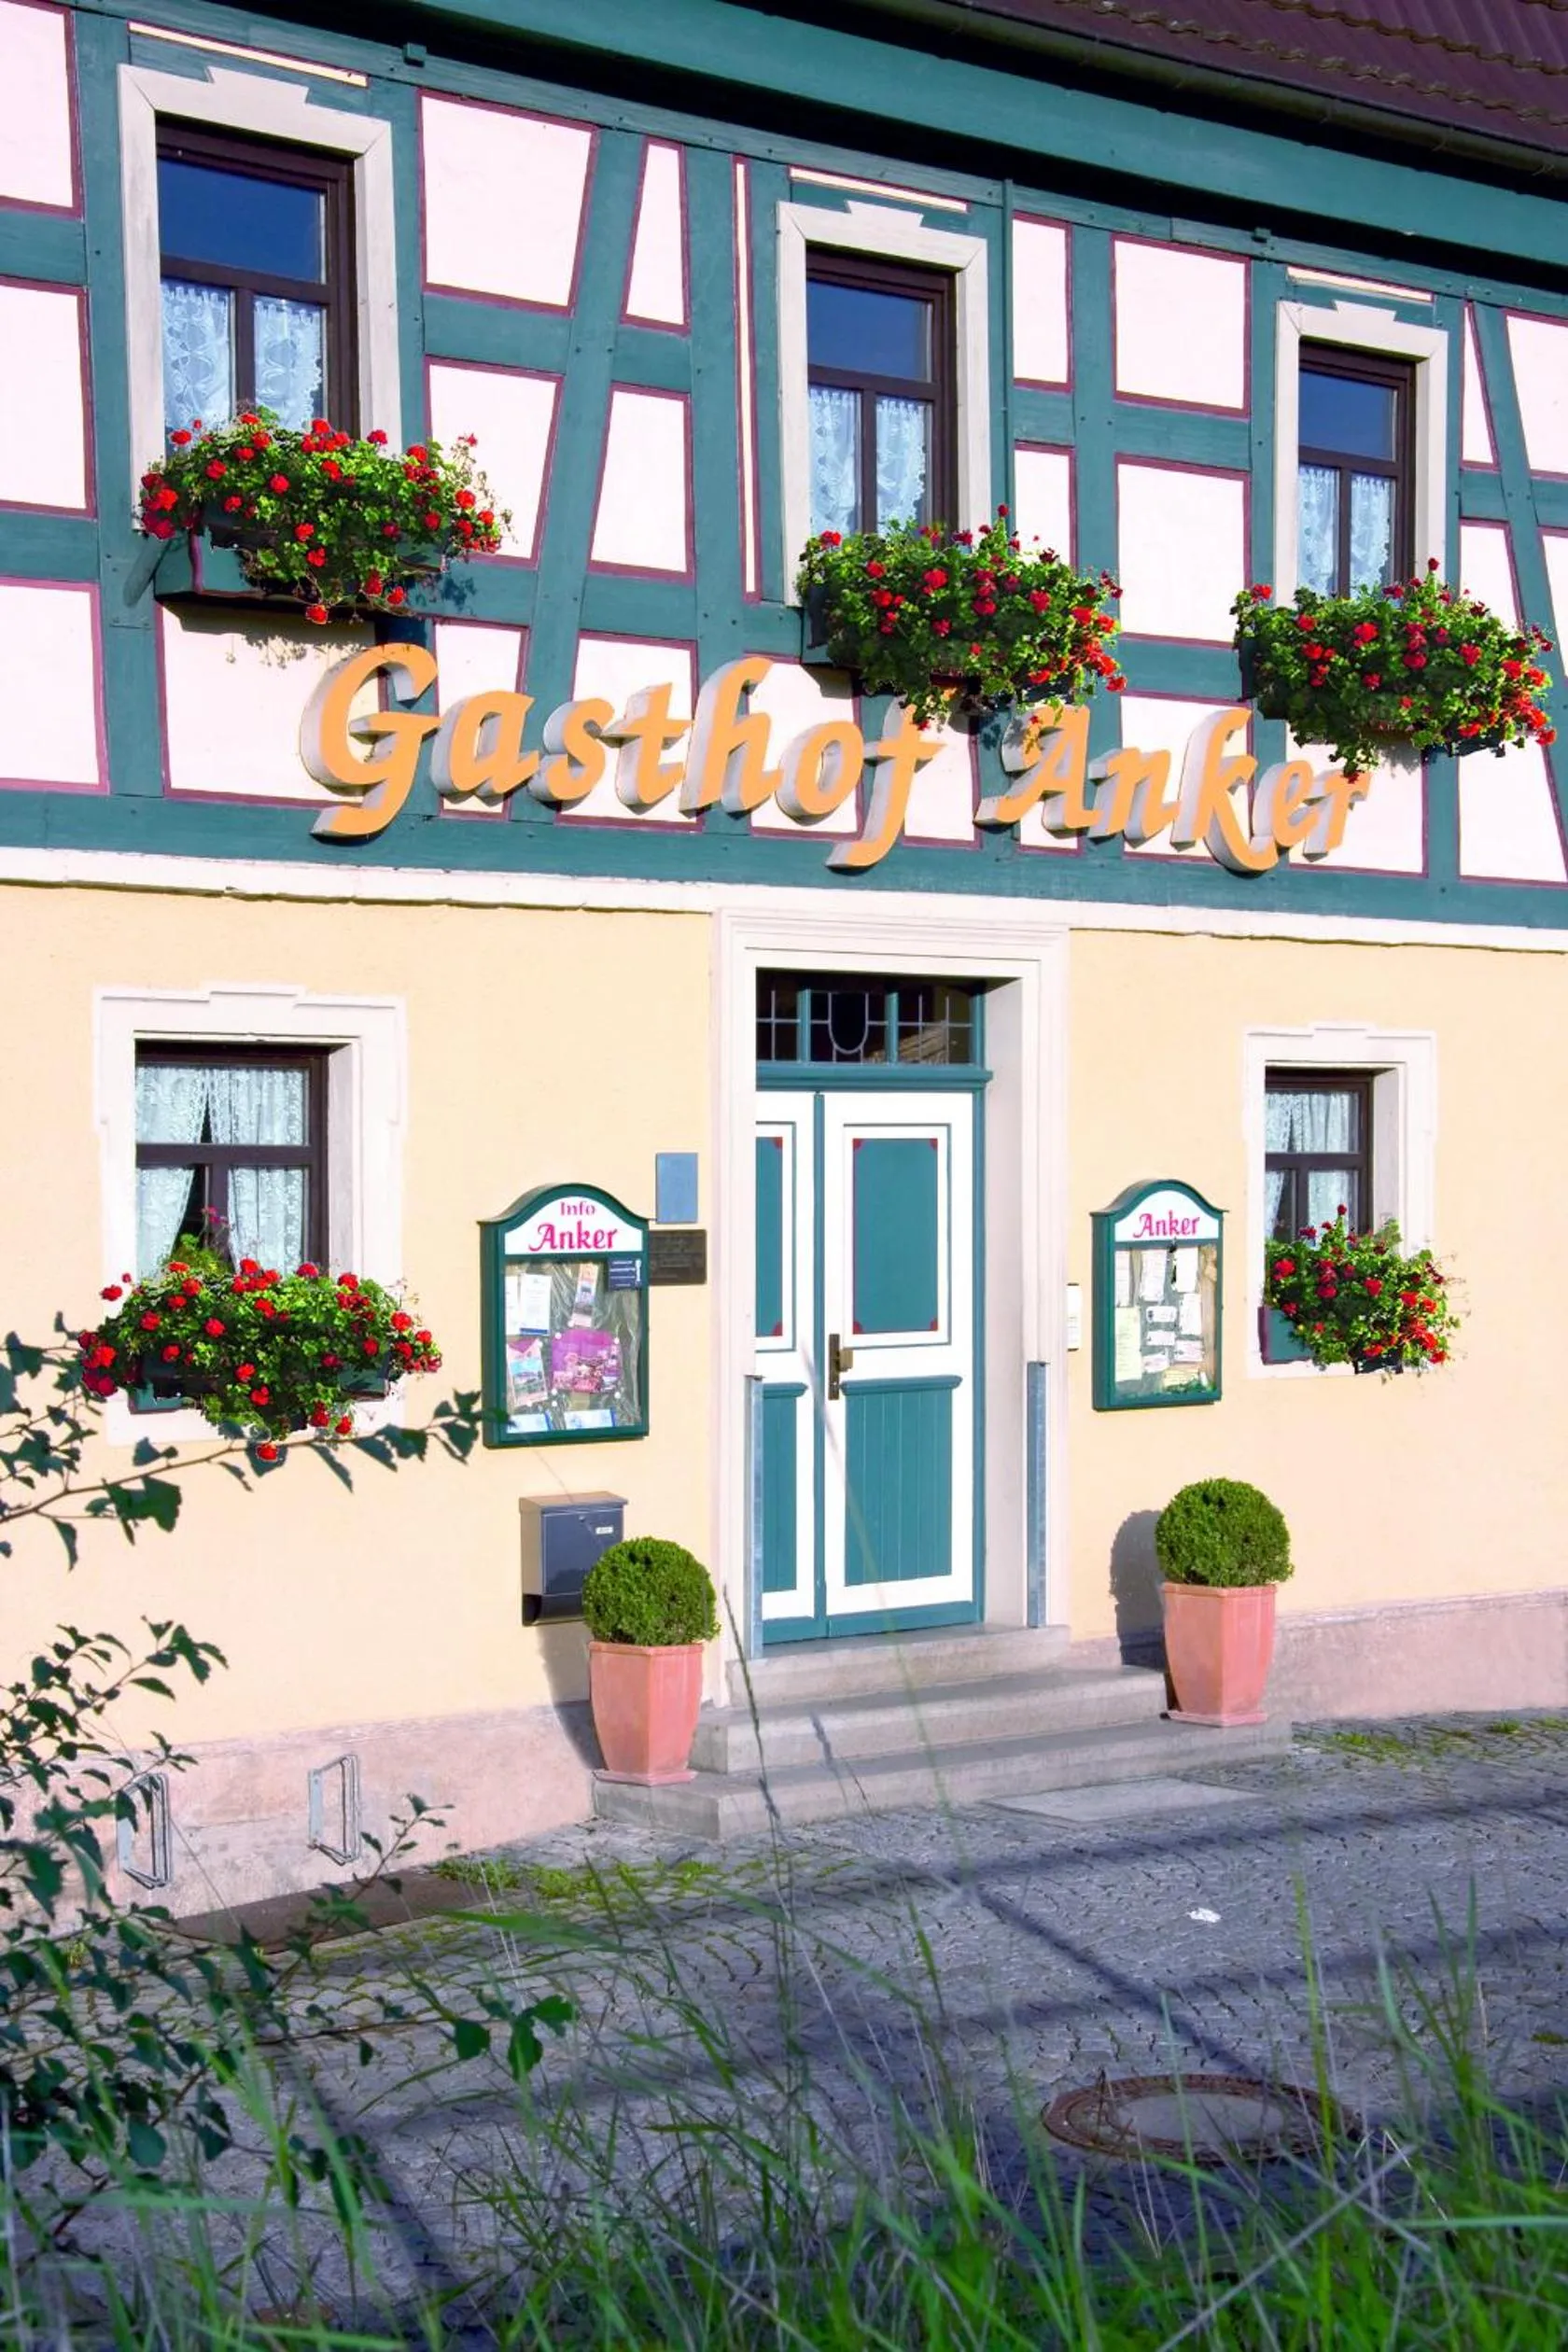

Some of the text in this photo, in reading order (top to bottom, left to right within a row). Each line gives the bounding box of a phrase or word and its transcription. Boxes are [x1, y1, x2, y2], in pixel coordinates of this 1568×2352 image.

[300, 642, 1371, 872] Gasthof Anker
[560, 1200, 595, 1216] Info
[528, 1220, 618, 1252] Anker
[1132, 1210, 1200, 1239] Anker
